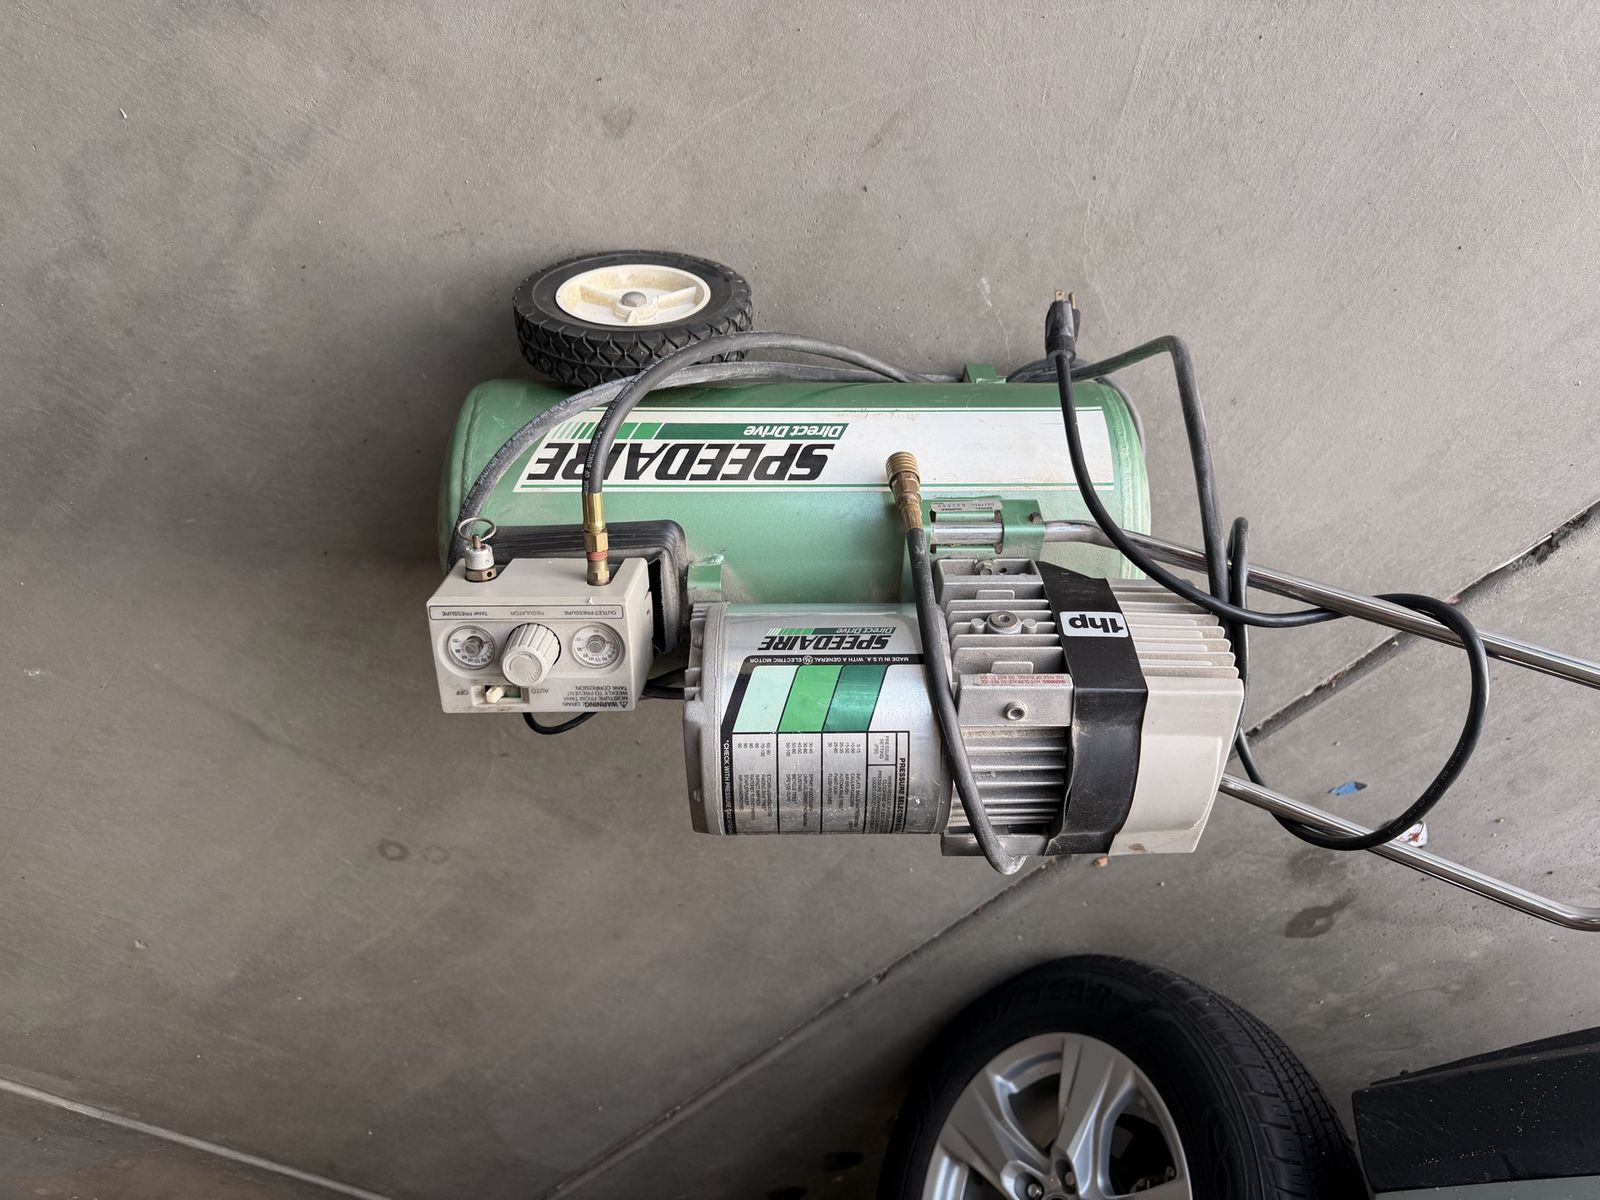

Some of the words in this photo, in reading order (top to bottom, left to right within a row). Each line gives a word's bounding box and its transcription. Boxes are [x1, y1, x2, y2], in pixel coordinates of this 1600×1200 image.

[744, 425, 787, 437] Drive
[791, 426, 843, 438] Direct
[527, 443, 835, 481] SPEEDAIRE
[1069, 614, 1123, 633] 1hp
[757, 635, 891, 650] SPEEDAIRE
